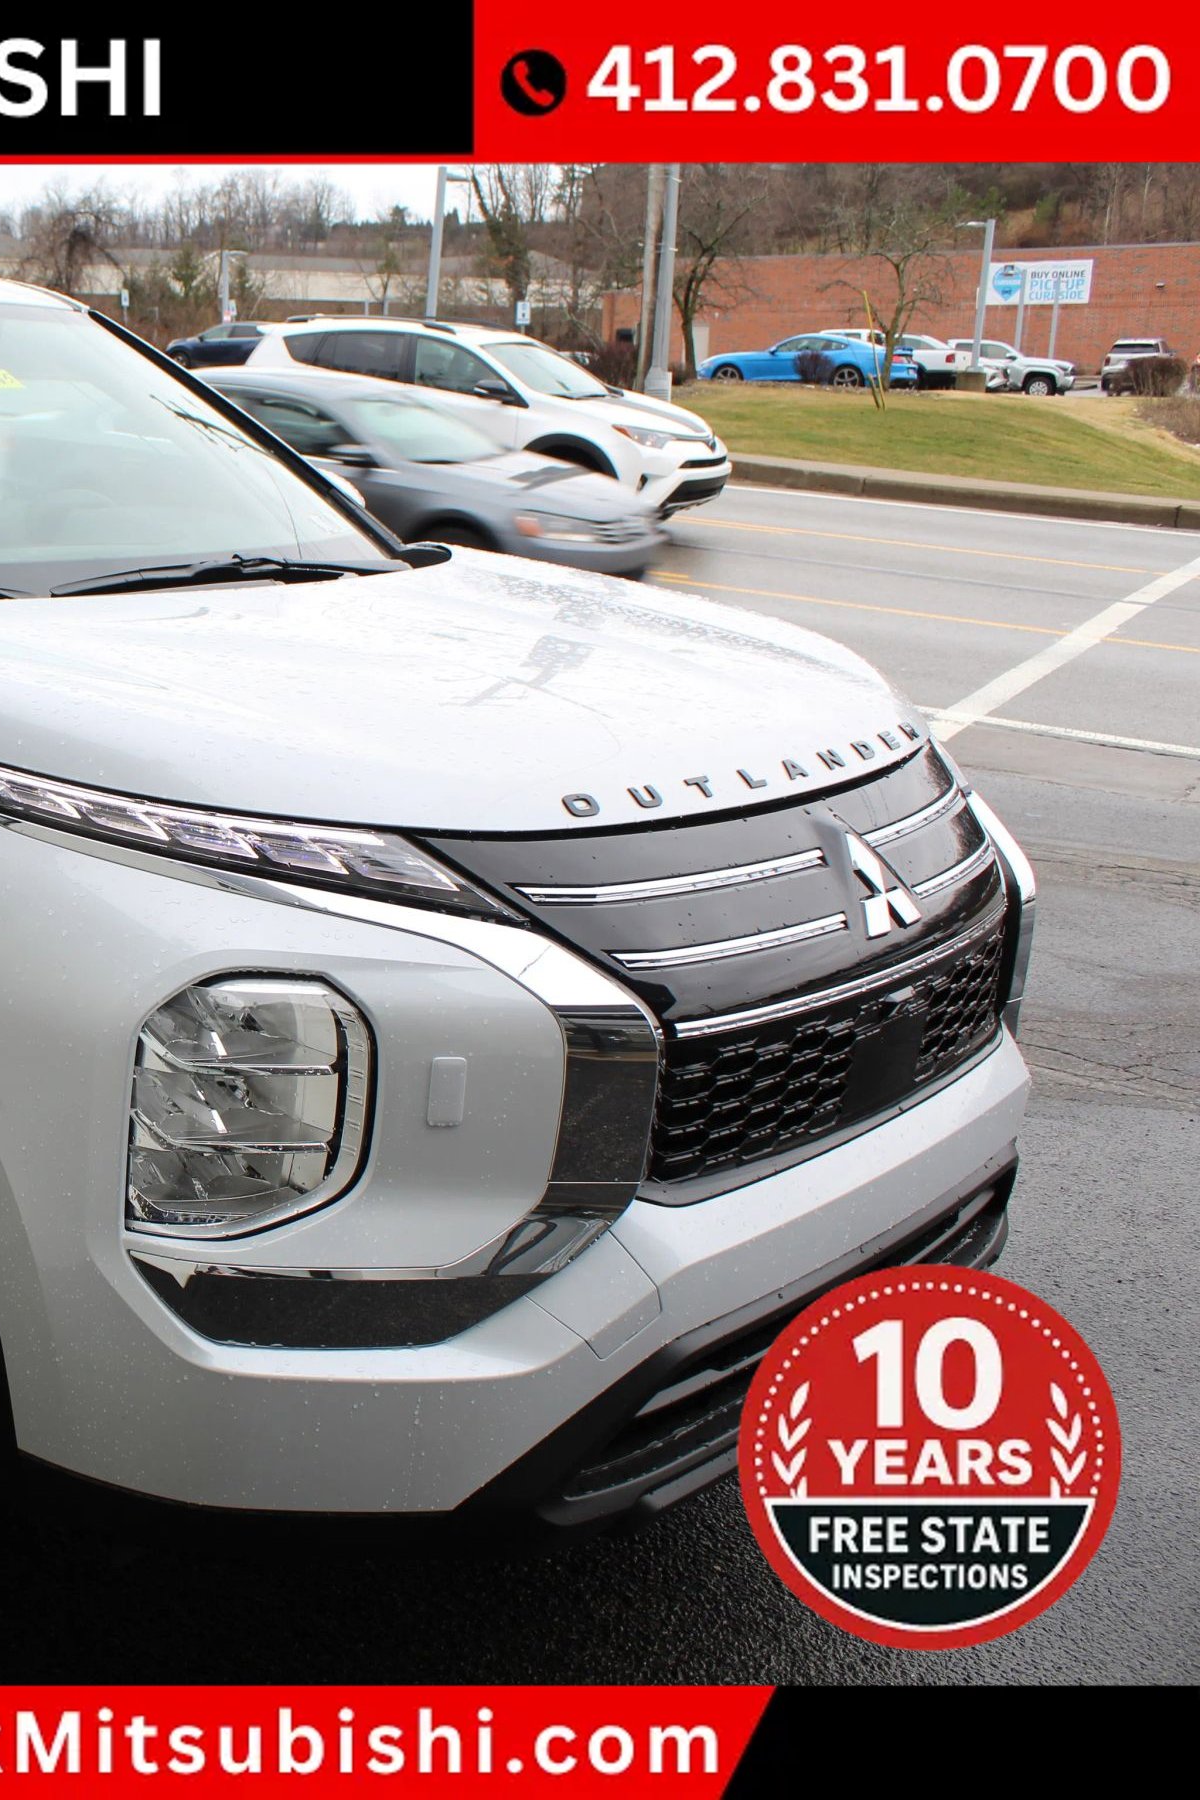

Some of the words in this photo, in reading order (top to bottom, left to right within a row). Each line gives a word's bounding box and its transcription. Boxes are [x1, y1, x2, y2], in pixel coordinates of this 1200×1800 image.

[1030, 271, 1049, 279] BUY
[1052, 269, 1086, 279] ONLINE
[561, 722, 920, 818] OUTLANDER
